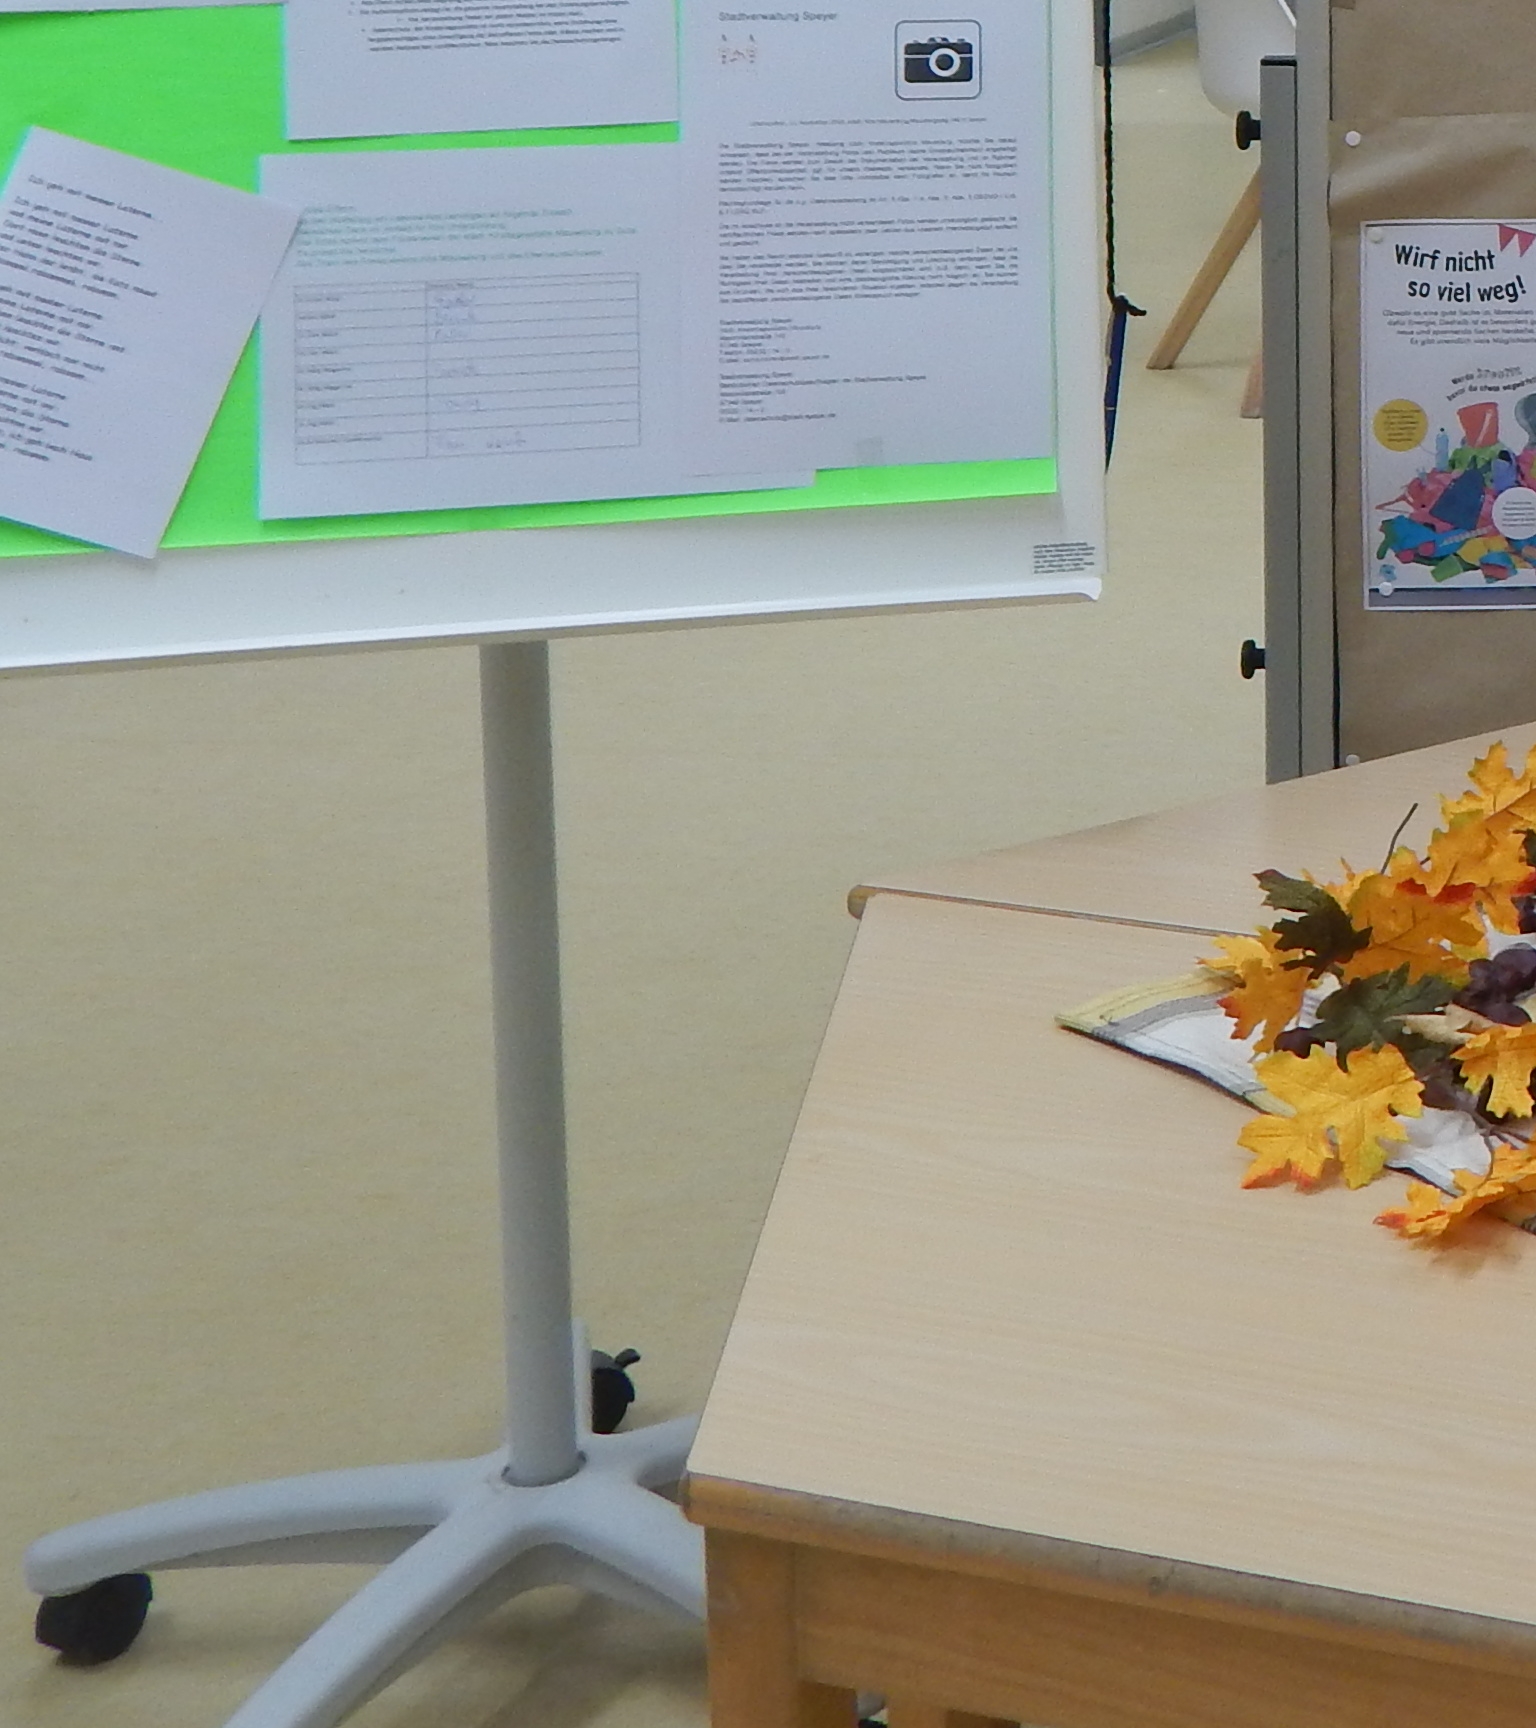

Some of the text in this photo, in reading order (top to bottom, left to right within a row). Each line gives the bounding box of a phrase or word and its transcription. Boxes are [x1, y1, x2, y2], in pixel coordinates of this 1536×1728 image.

[1396, 244, 1496, 272] Wirf nicht
[1407, 275, 1527, 303] so viel weg!
